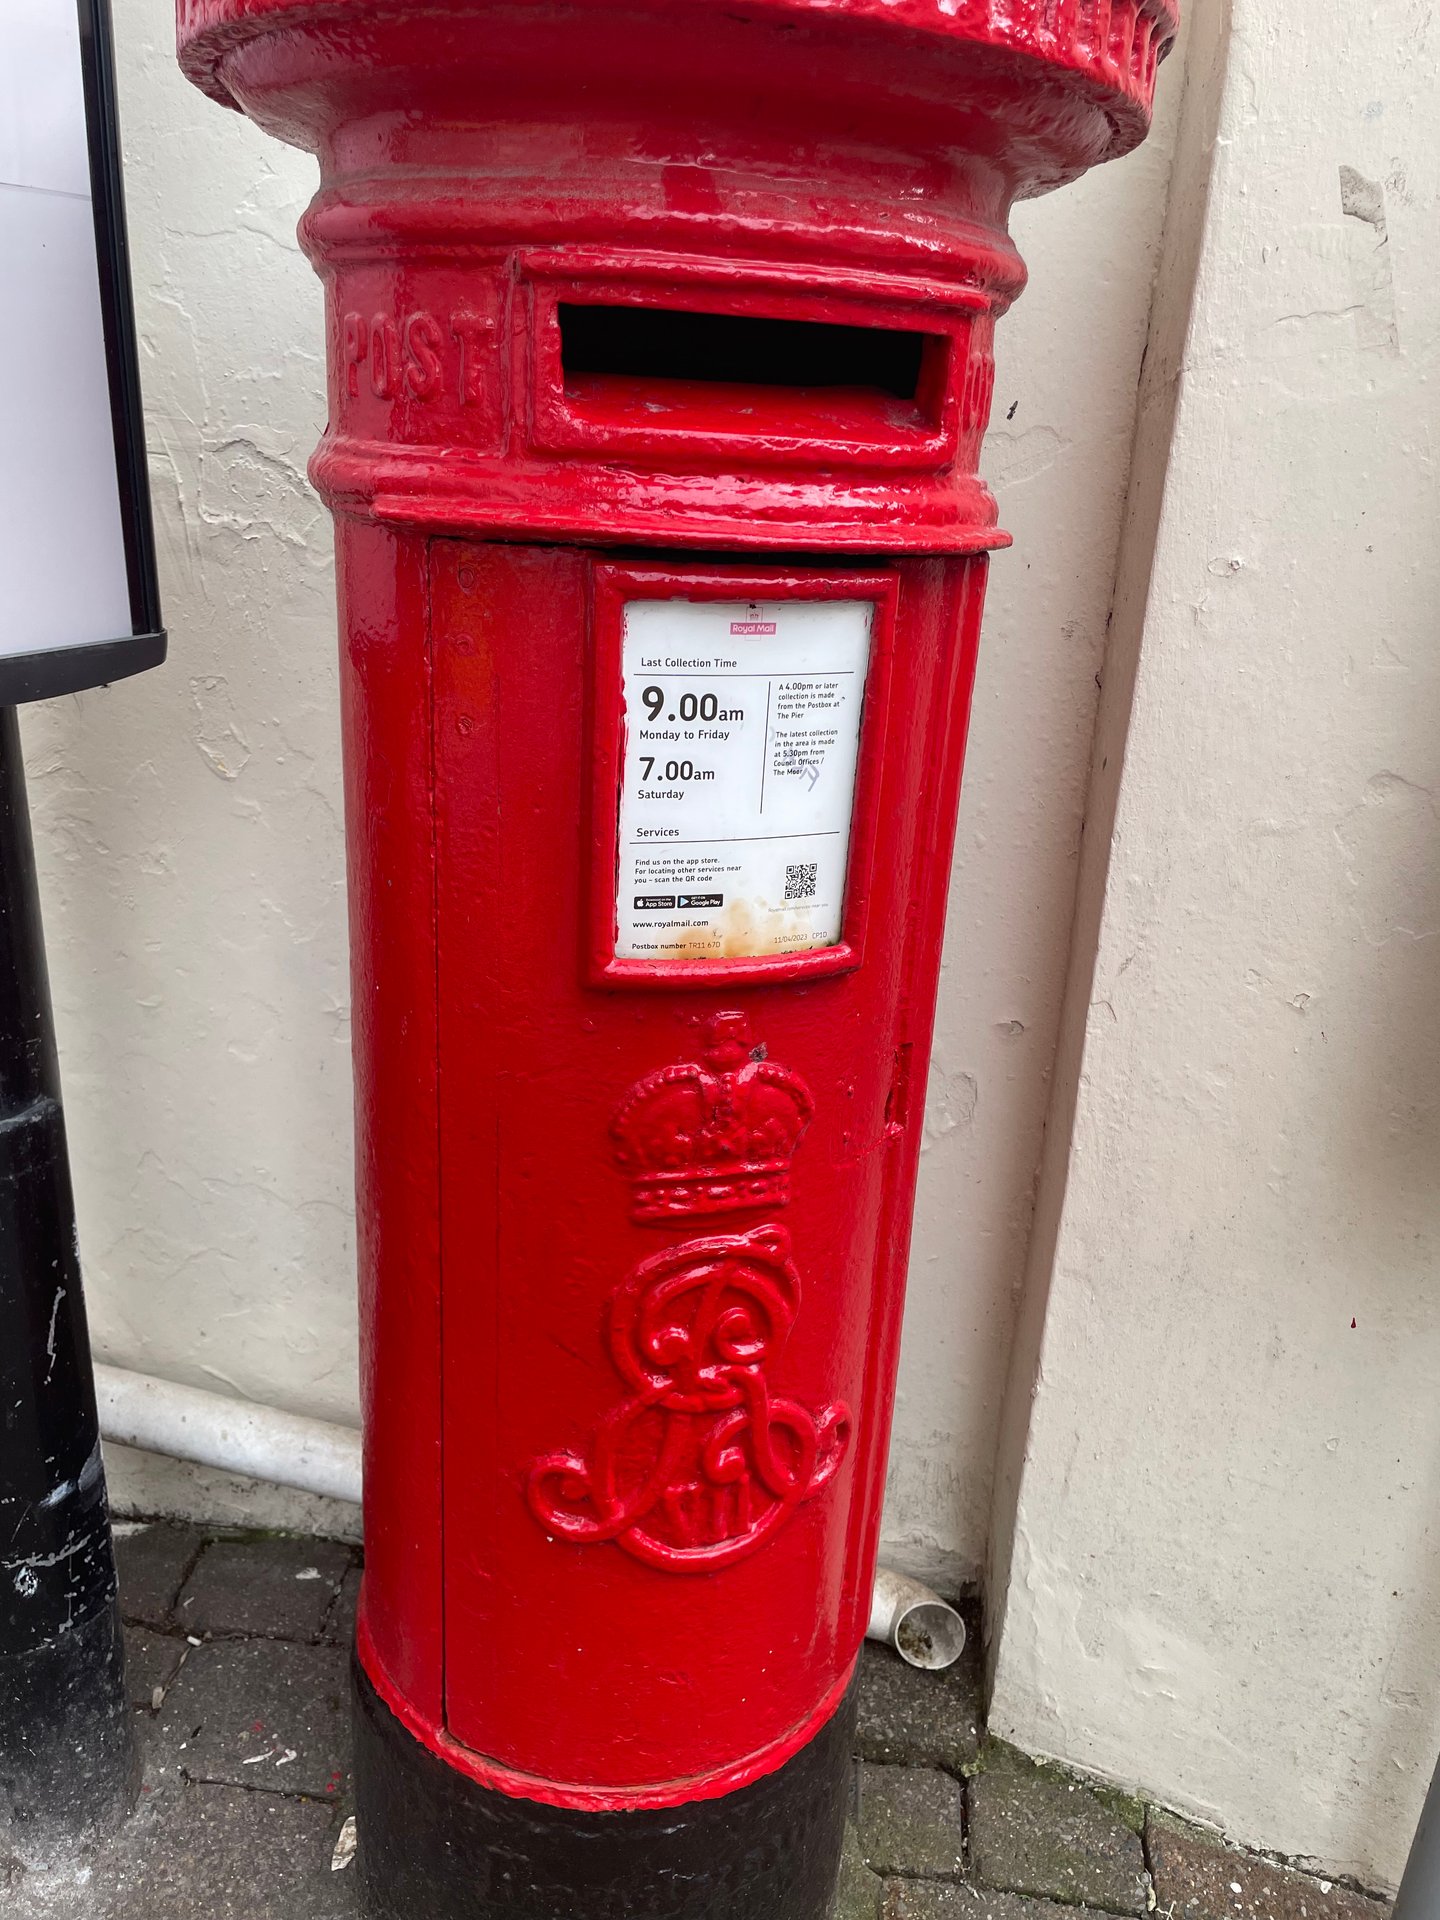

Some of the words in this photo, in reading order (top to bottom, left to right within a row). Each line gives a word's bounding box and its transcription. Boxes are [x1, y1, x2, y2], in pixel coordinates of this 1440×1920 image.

[343, 311, 496, 405] POST
[733, 624, 755, 634] Royal
[757, 624, 774, 632] Mail
[641, 657, 662, 667] Last
[665, 658, 711, 667] Collection
[714, 659, 737, 667] Time
[785, 682, 813, 691] 4.00pm
[642, 686, 744, 721] 9.00am
[807, 701, 832, 709] Postbox
[640, 730, 680, 741] Monday
[684, 731, 694, 739] to
[698, 730, 730, 740] Friday
[789, 730, 808, 738] latest
[809, 729, 838, 737] collection
[783, 749, 809, 758] 5.30pm
[773, 759, 797, 767] Council
[798, 758, 820, 766] Offices
[639, 757, 715, 780] 7.00am
[638, 789, 685, 800] Saturday
[636, 827, 680, 837] Services
[648, 867, 675, 875] locating
[690, 899, 709, 907] Google
[633, 920, 709, 928] www.royalmail.com
[774, 934, 807, 944] 11/04/2023
